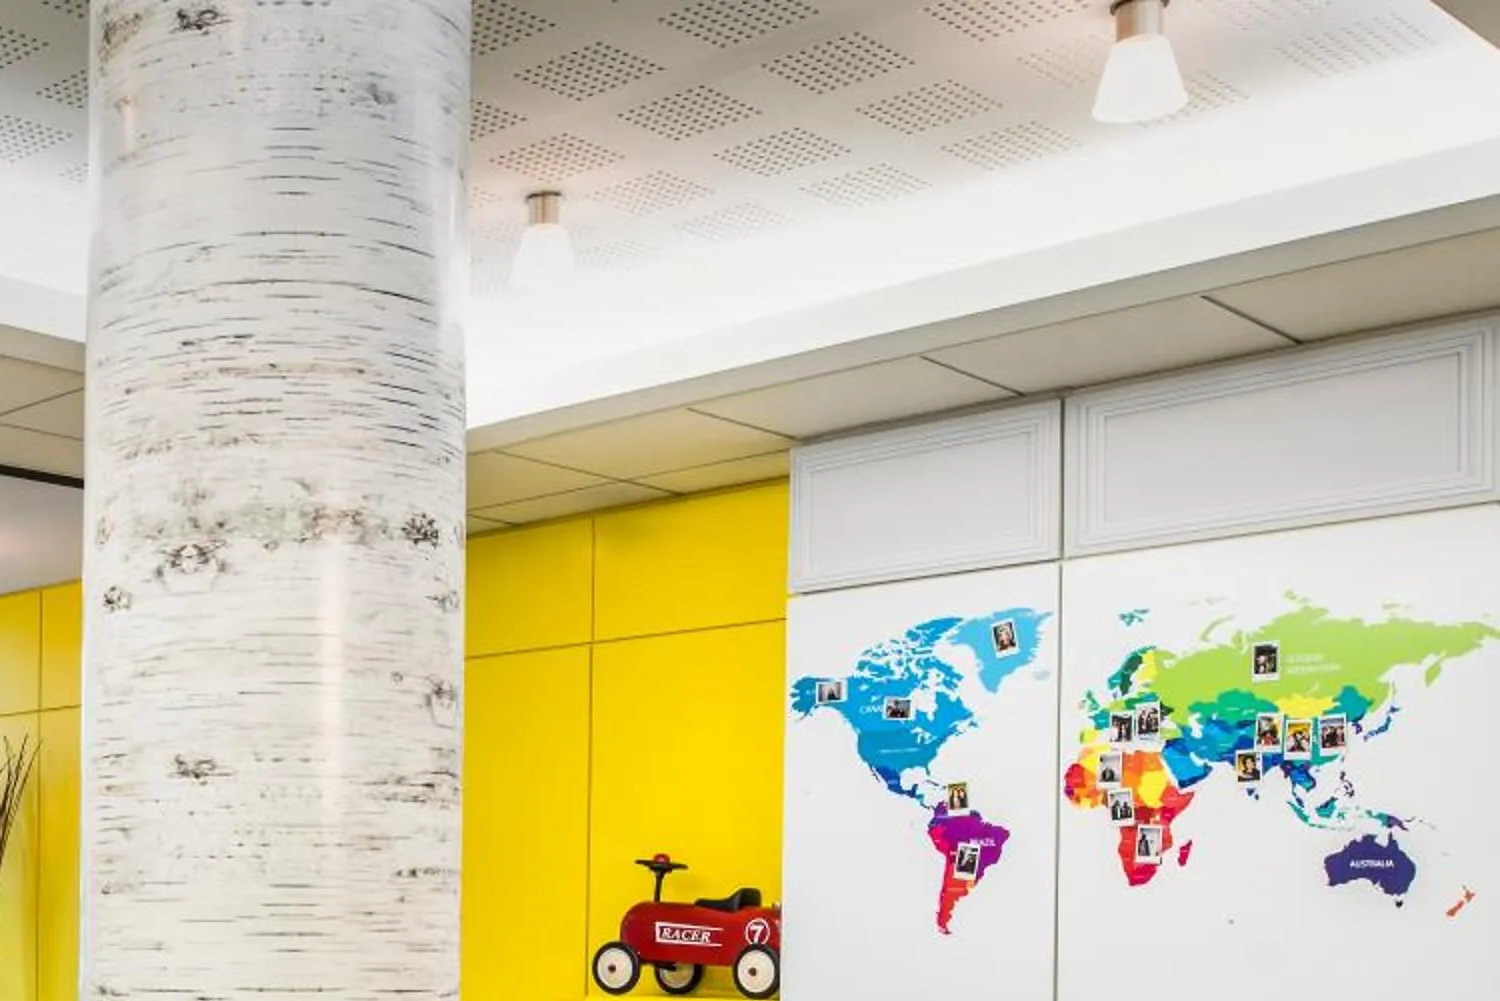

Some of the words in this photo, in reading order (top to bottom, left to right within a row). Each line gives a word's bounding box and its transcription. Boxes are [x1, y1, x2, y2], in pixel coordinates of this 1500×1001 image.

[1349, 859, 1395, 868] AUSTRALIA
[661, 927, 711, 943] RACER
[750, 924, 765, 943] 7
